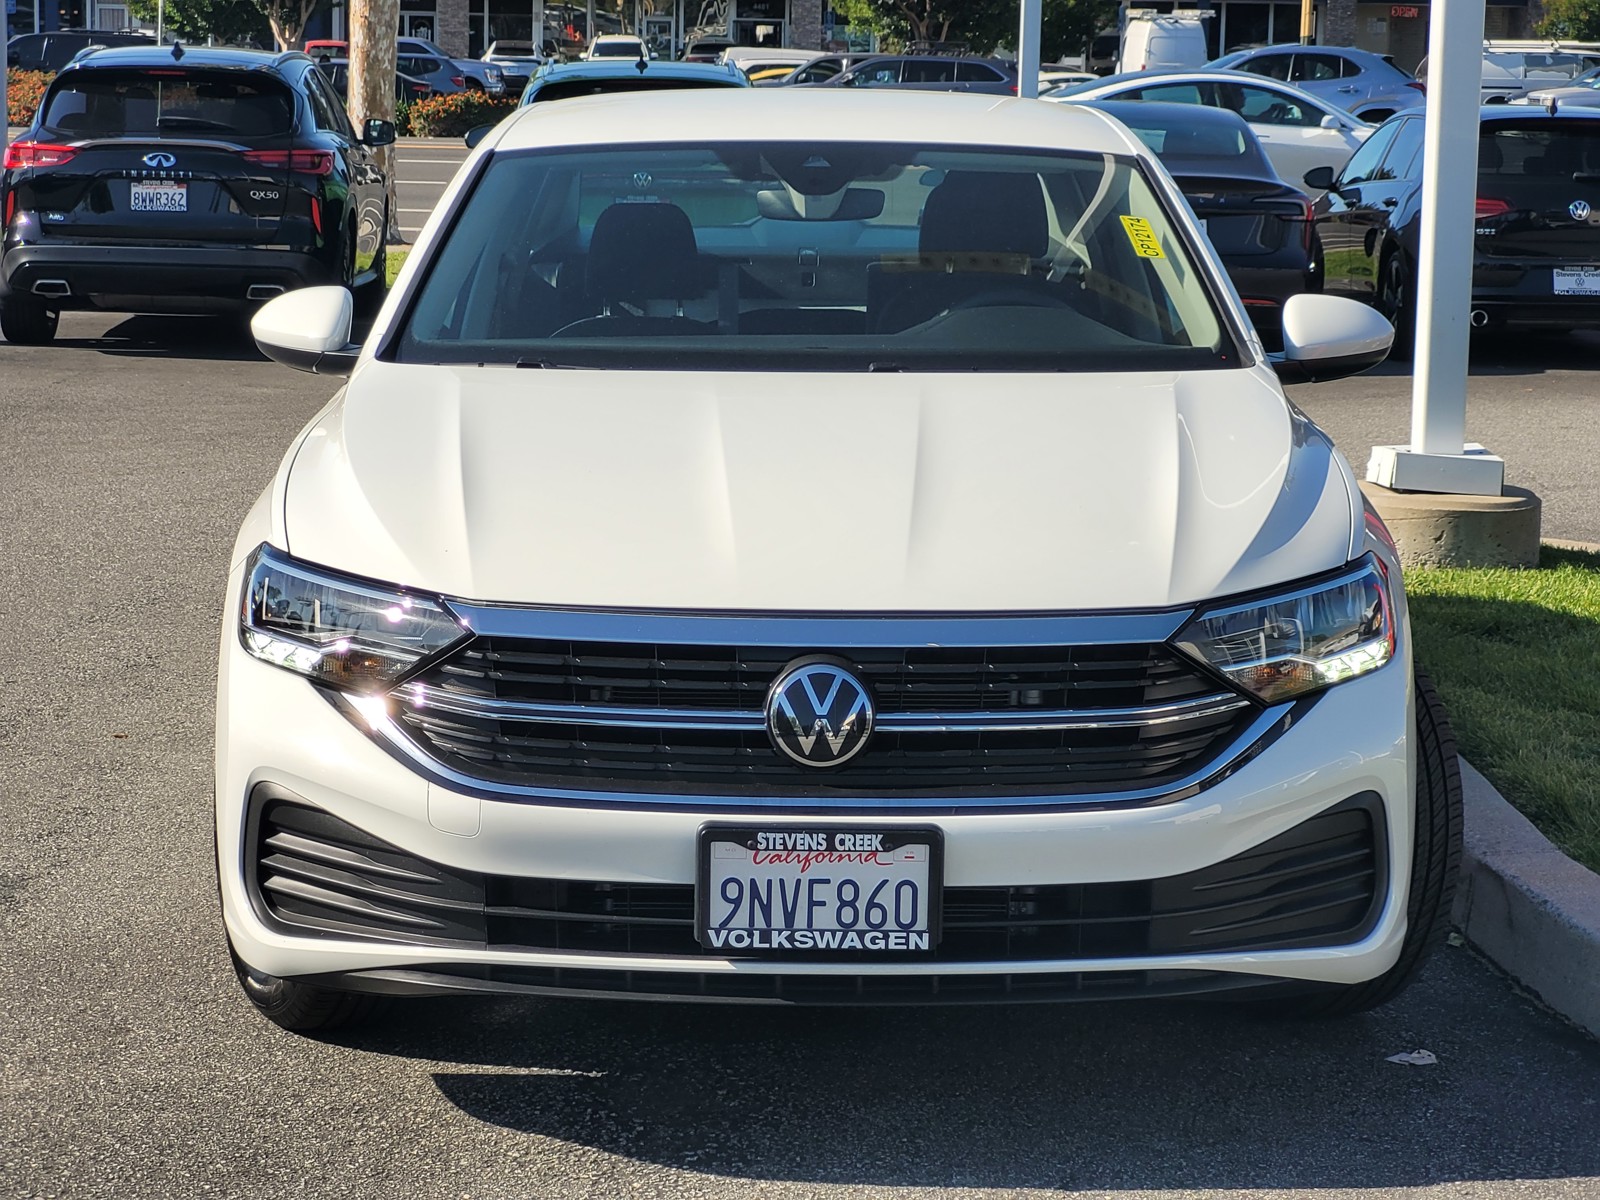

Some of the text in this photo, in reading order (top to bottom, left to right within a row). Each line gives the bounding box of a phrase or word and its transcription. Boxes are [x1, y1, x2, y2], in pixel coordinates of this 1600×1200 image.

[1391, 6, 1418, 18] OPEN
[122, 169, 193, 179] INFINITI
[133, 191, 184, 207] 8WWR362
[250, 190, 279, 200] QX50
[130, 204, 187, 212] VOLKSWAGEN
[1127, 217, 1159, 257] CP12174
[757, 832, 884, 851] STEVENS CREEK
[752, 849, 894, 874] California
[718, 877, 919, 930] 9NVF860
[707, 929, 929, 950] VOLKSWAGEN
